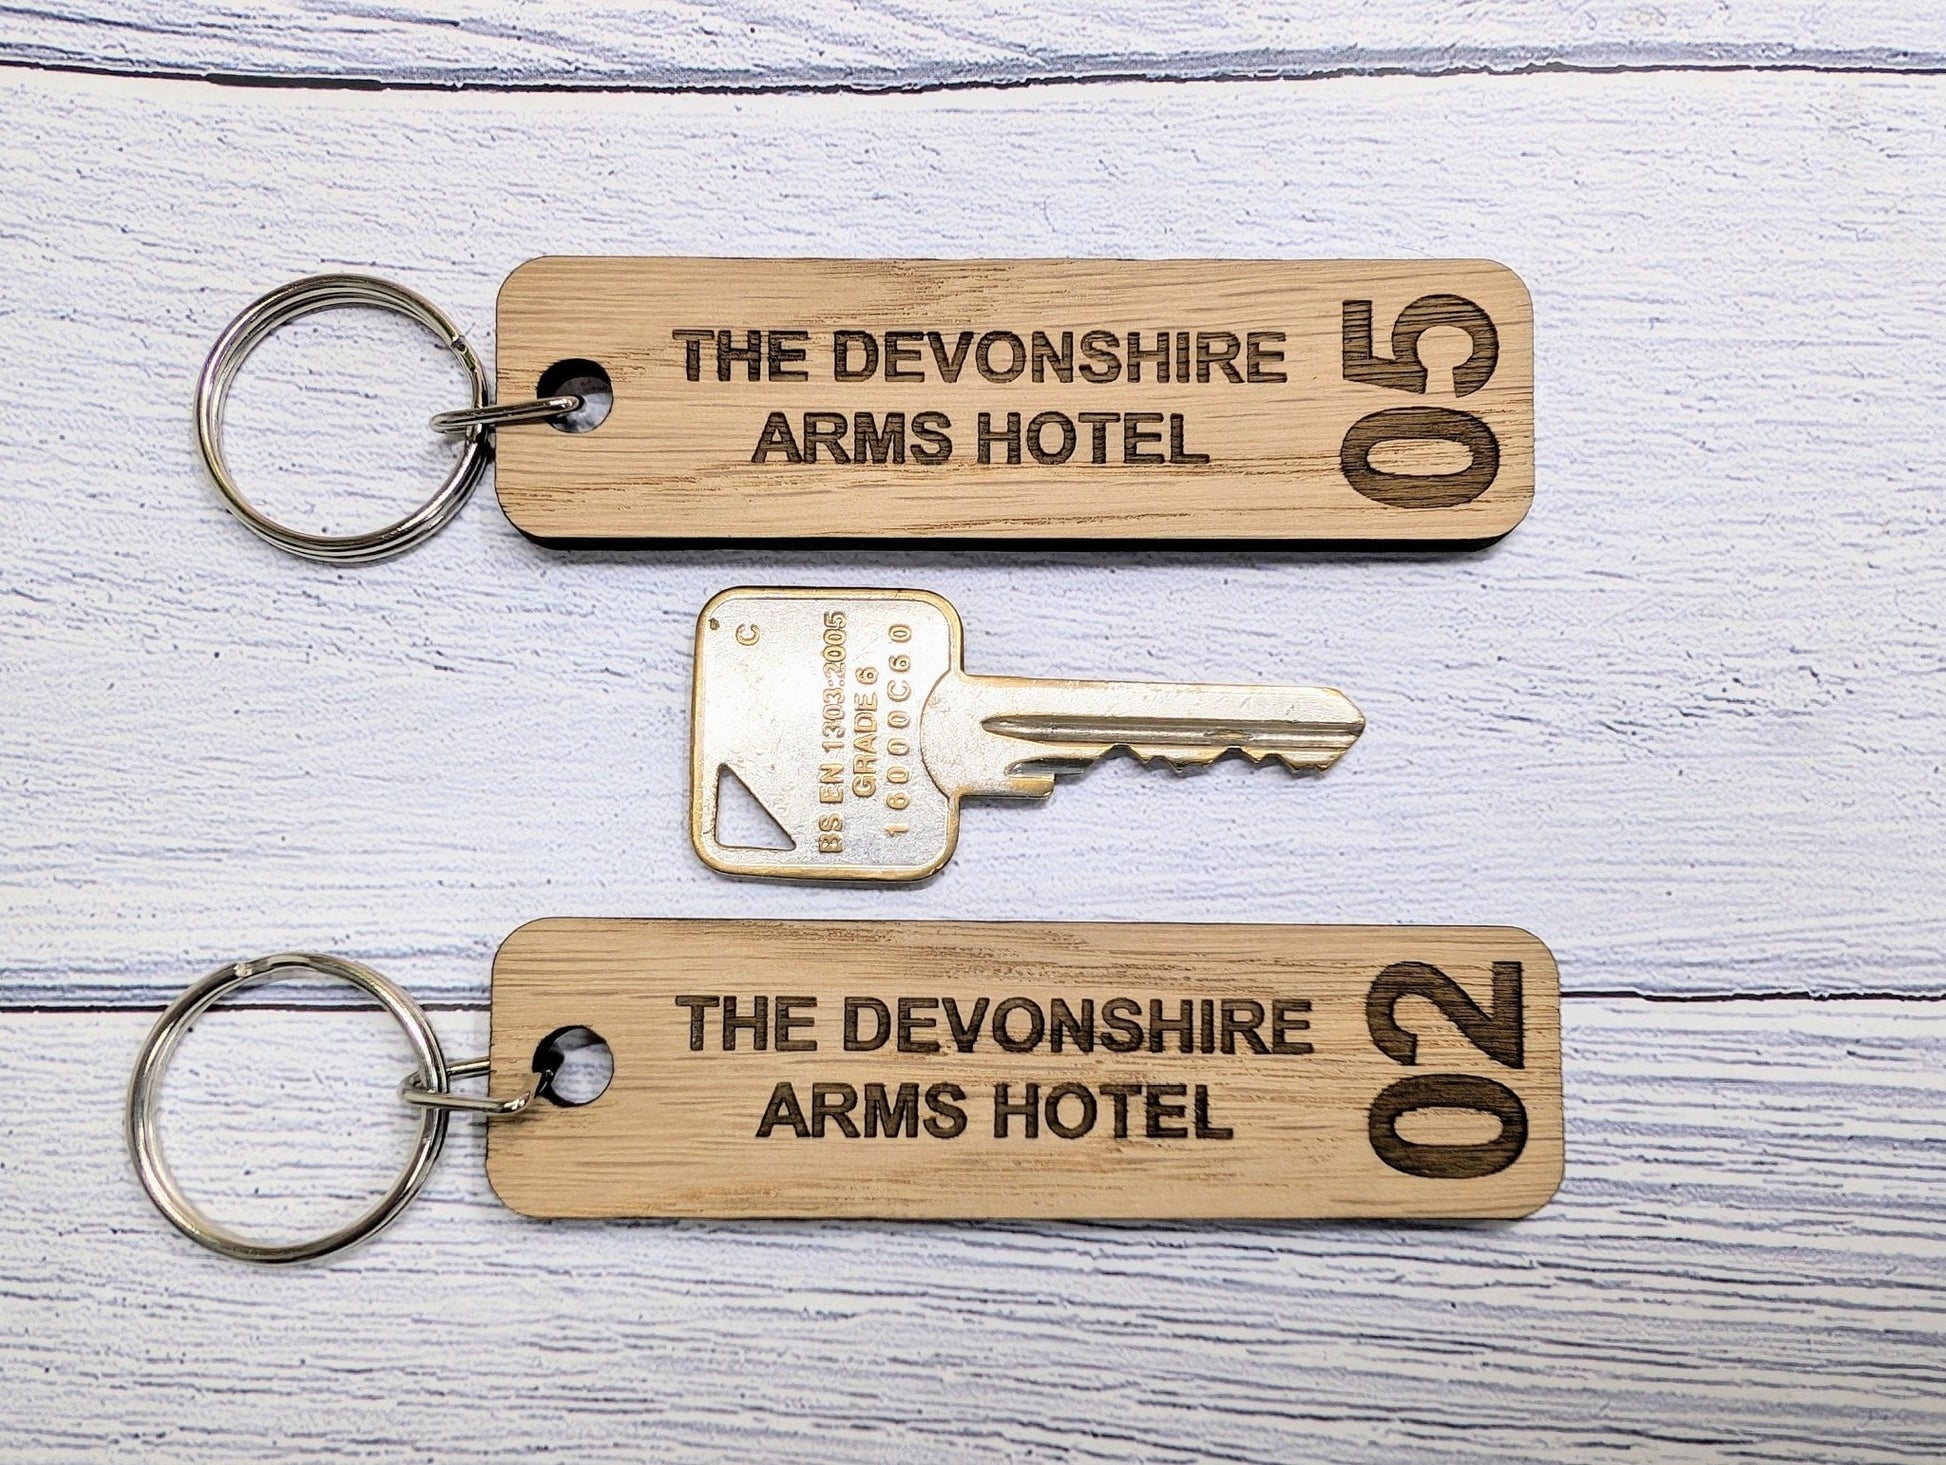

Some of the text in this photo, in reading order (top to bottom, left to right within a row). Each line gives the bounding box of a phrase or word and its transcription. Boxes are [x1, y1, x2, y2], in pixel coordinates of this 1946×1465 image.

[671, 329, 1288, 384] THE DEVONSHIRE
[1340, 293, 1502, 510] 05
[750, 410, 1212, 466] ARMS HOTEL
[735, 622, 760, 646] C
[818, 610, 848, 854] BS EN 1303:2005
[851, 666, 879, 799] GRADE 6
[674, 993, 1315, 1056] THE DEVONSHIRE
[1364, 959, 1531, 1181] 02
[753, 1080, 1236, 1141] ARMS HOTEL
